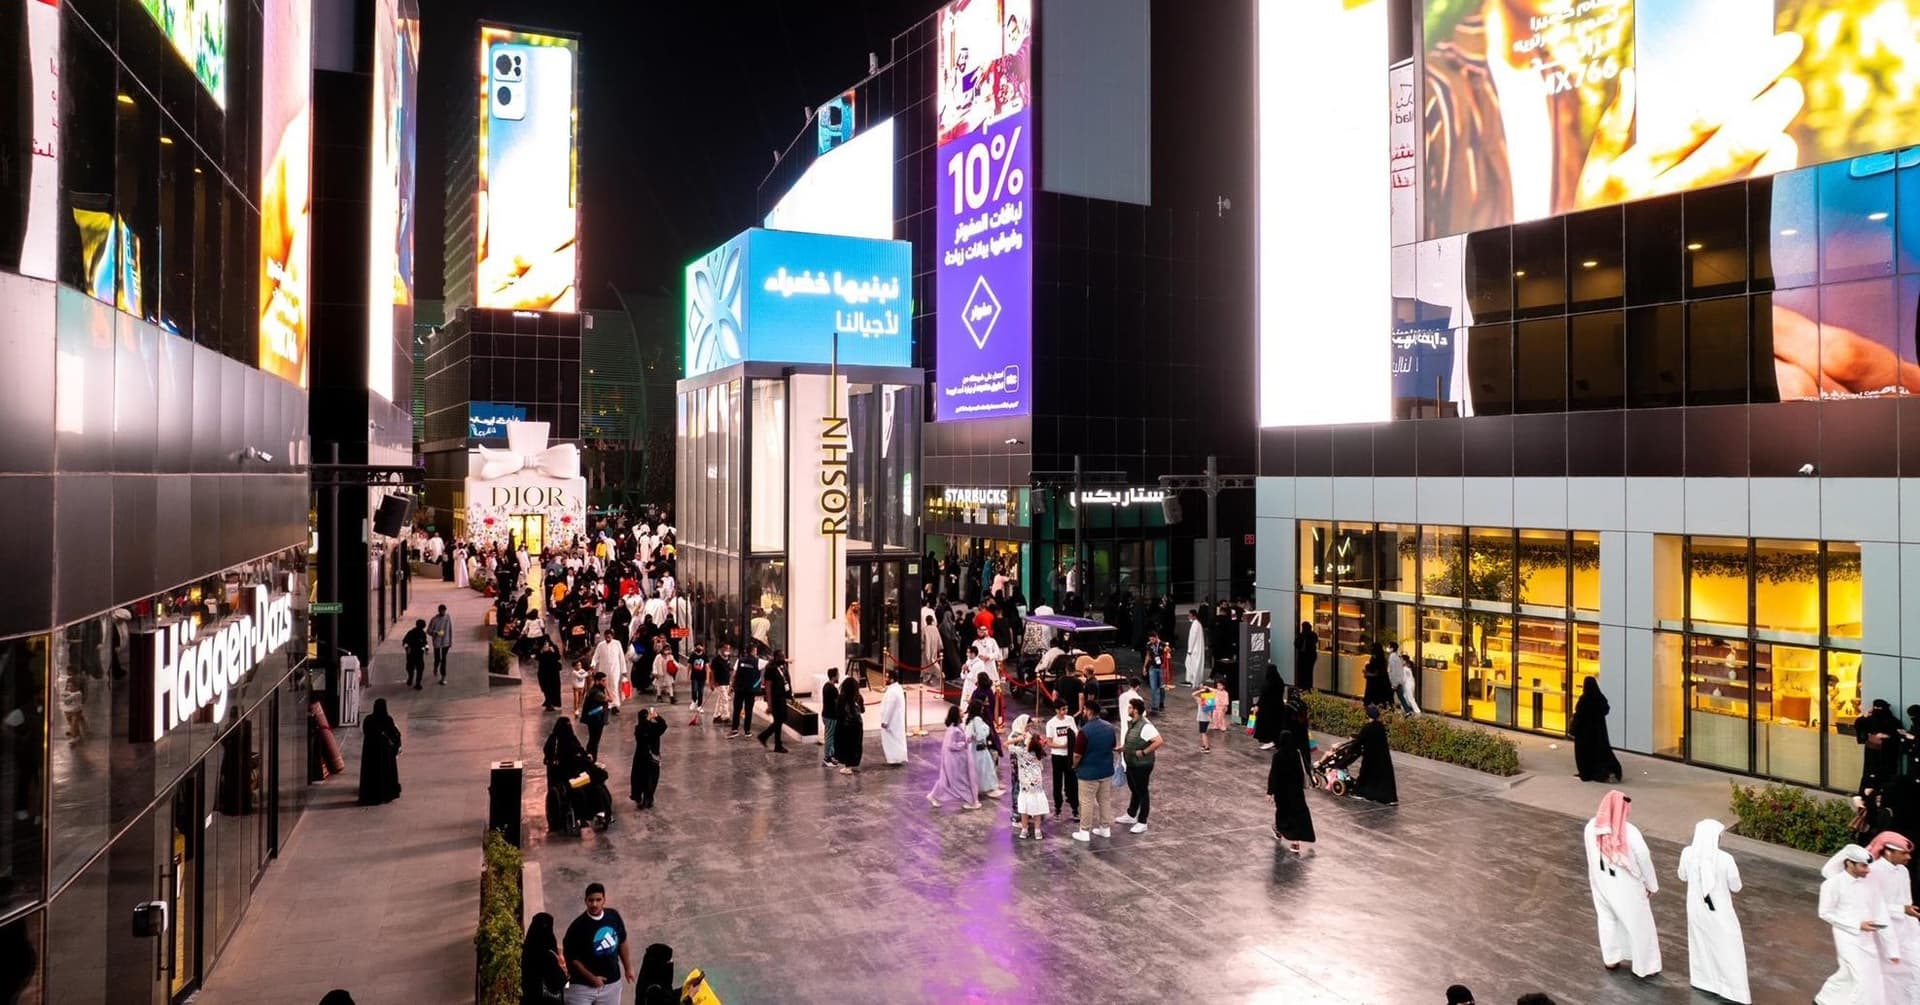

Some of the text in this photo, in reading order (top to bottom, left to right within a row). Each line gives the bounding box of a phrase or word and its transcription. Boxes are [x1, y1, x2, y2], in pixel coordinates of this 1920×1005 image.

[948, 126, 1024, 214] 10%
[764, 267, 899, 305] نبنيها خضراء
[836, 309, 899, 338] لأجيالنا
[820, 417, 848, 535] ROSHN
[490, 486, 566, 506] DIOR
[944, 488, 1008, 505] STARBUCKS
[1069, 487, 1165, 508] ستاربكس
[154, 584, 292, 742] Häagen-Dazs
